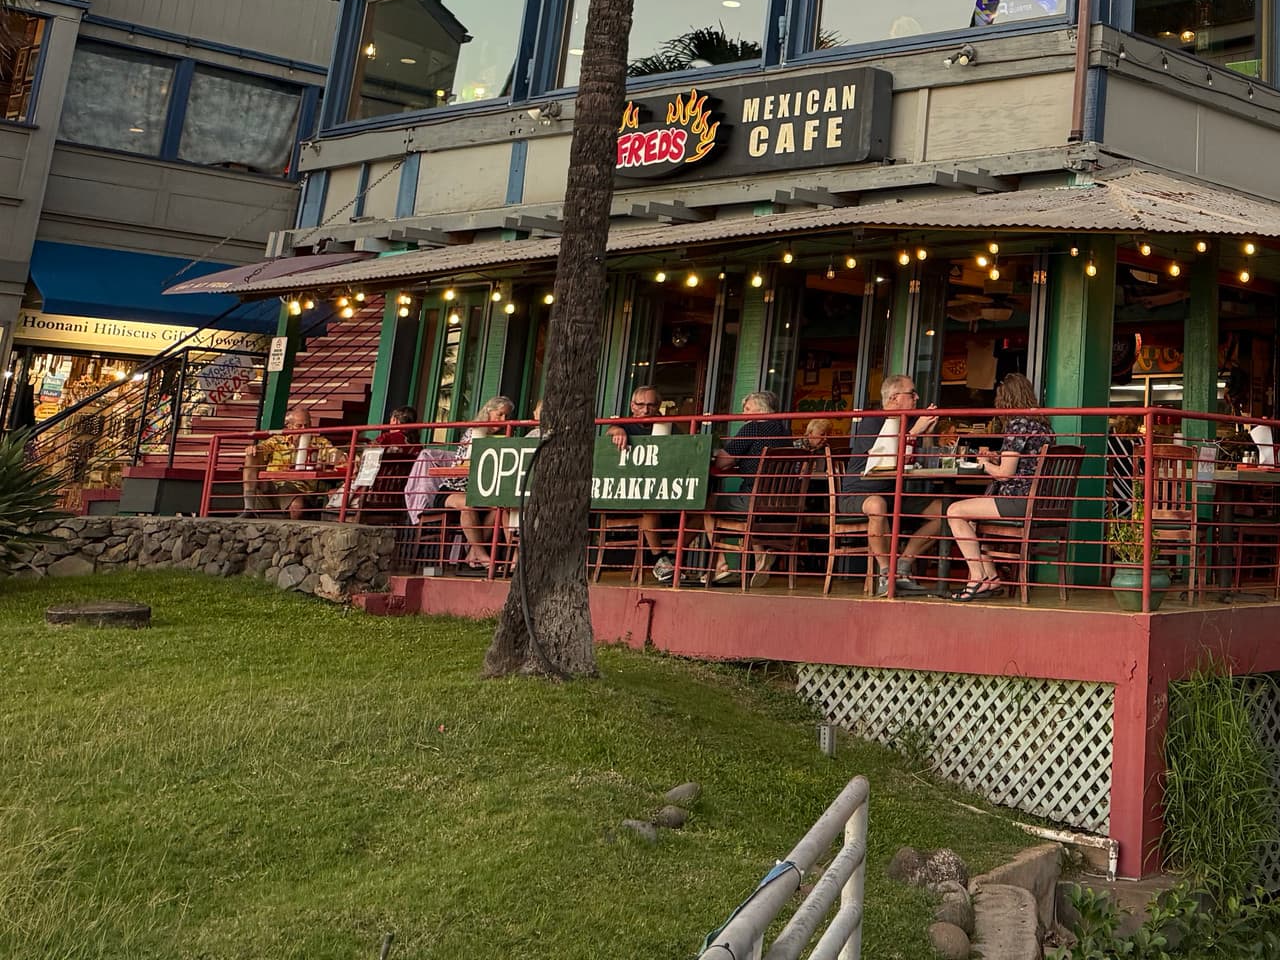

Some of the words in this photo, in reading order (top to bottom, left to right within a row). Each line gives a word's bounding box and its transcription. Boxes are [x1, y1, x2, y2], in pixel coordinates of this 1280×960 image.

[742, 84, 857, 123] MEXICAN
[616, 127, 688, 169] FRED'S
[748, 116, 844, 158] CAFE
[23, 315, 88, 333] Hoonani
[94, 323, 157, 340] Hibiscus
[477, 447, 538, 497] OPE
[618, 444, 659, 467] FOR
[591, 477, 698, 501] REAKFAST
